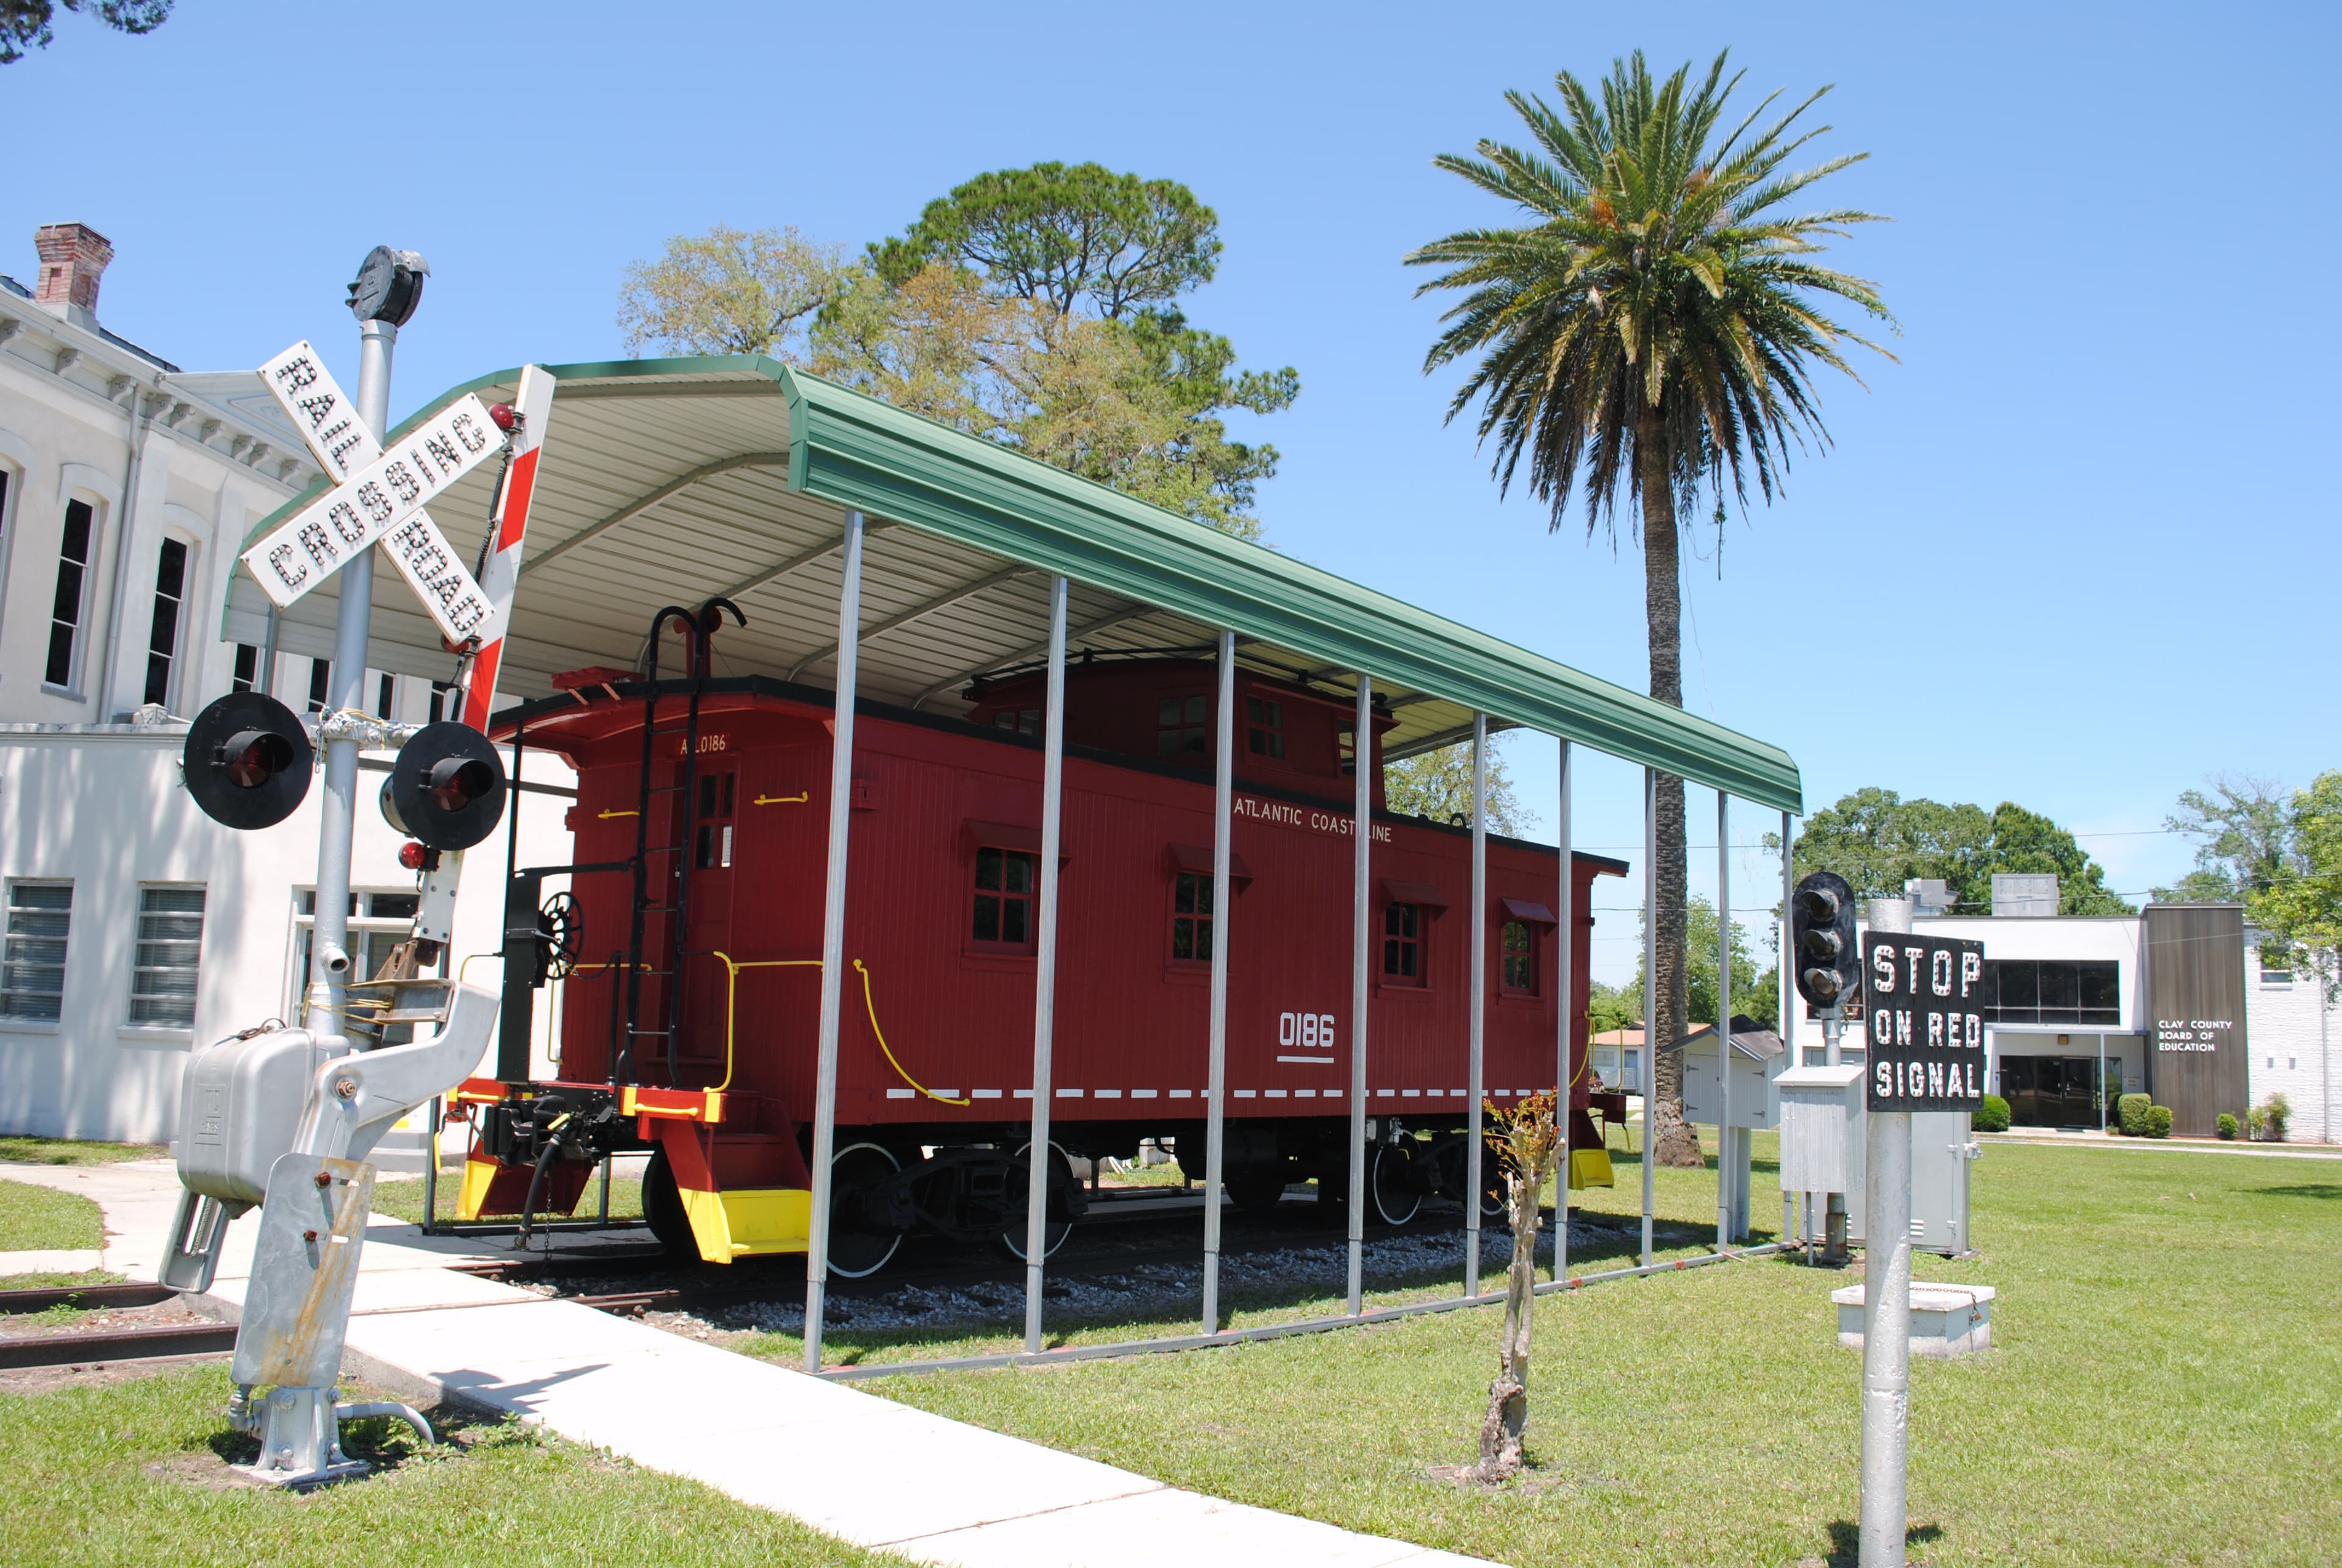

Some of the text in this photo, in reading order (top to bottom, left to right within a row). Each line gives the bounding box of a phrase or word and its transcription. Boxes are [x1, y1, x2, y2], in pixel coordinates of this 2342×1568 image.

[276, 355, 361, 470] RAIL
[269, 413, 485, 586] CROSSING
[392, 518, 484, 632] ROAD
[680, 734, 726, 755] A0186
[1234, 798, 1391, 842] ATLANTIC COAST INE
[1874, 945, 1980, 997] STOP
[1280, 1012, 1334, 1047] 0186
[1875, 1009, 1980, 1048] ON RED
[2158, 1020, 2232, 1029] CLAY COUNTY
[2158, 1031, 2215, 1040] BOARD OF
[2158, 1043, 2215, 1051] EDUCATION
[1876, 1061, 1980, 1097] SIGNAL
